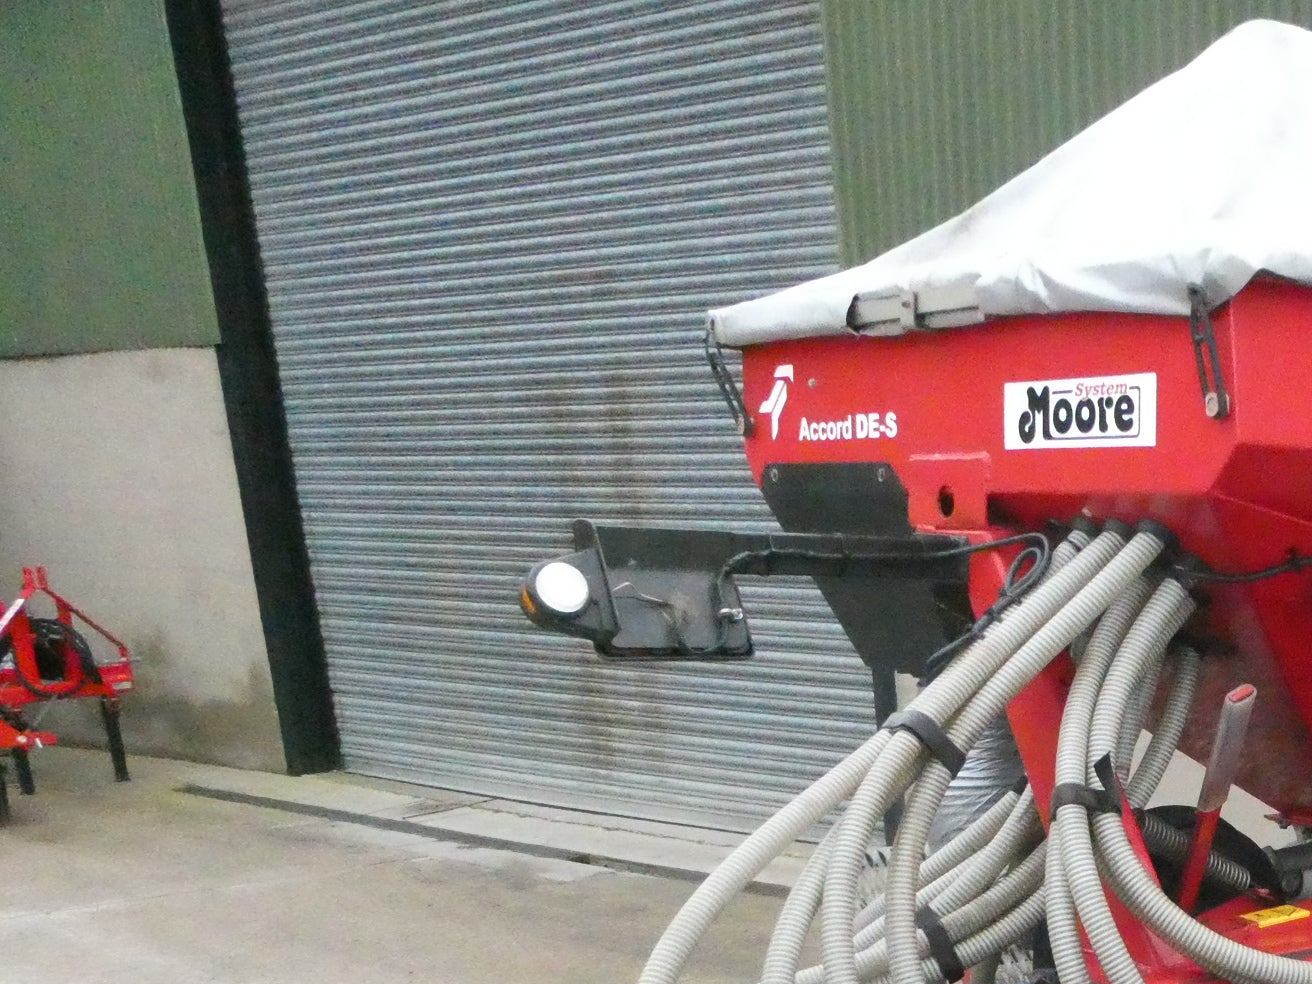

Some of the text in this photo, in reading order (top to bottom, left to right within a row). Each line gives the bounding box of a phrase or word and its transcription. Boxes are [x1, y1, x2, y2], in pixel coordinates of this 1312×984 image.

[1074, 382, 1128, 401] System
[799, 411, 898, 441] Accord DE-S
[1018, 385, 1135, 443] Moore
